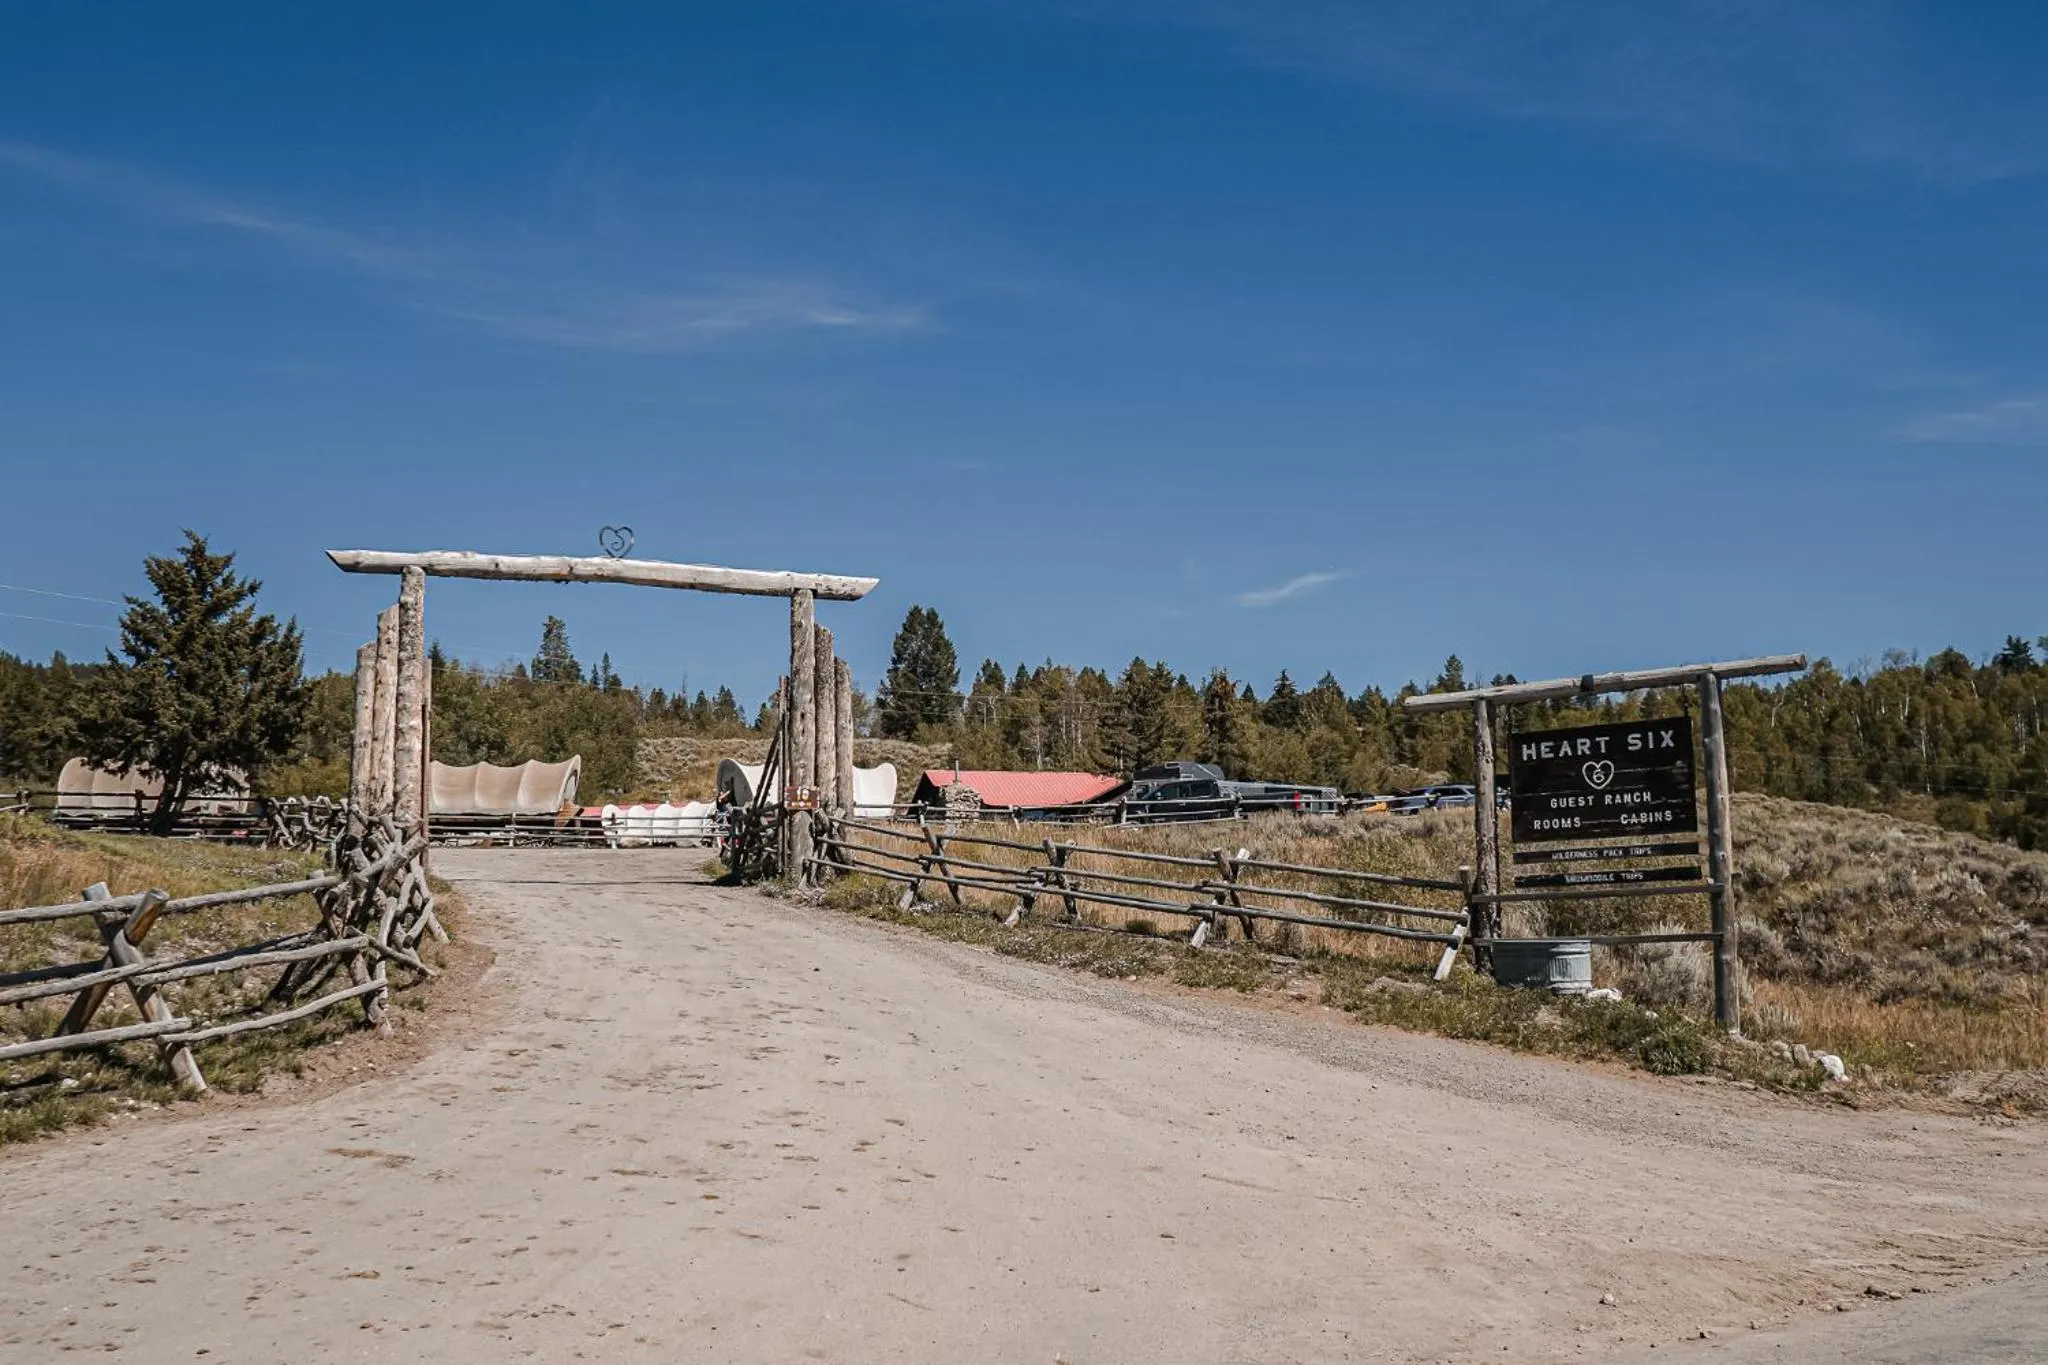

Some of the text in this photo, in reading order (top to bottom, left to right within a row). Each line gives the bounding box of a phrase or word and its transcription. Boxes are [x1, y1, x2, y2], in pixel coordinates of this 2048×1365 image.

[1522, 730, 1675, 761] HEART SIX
[1592, 769, 1605, 783] 6
[1550, 792, 1652, 808] GUEST RANCH
[1533, 810, 1673, 830] ROOMS CABINS
